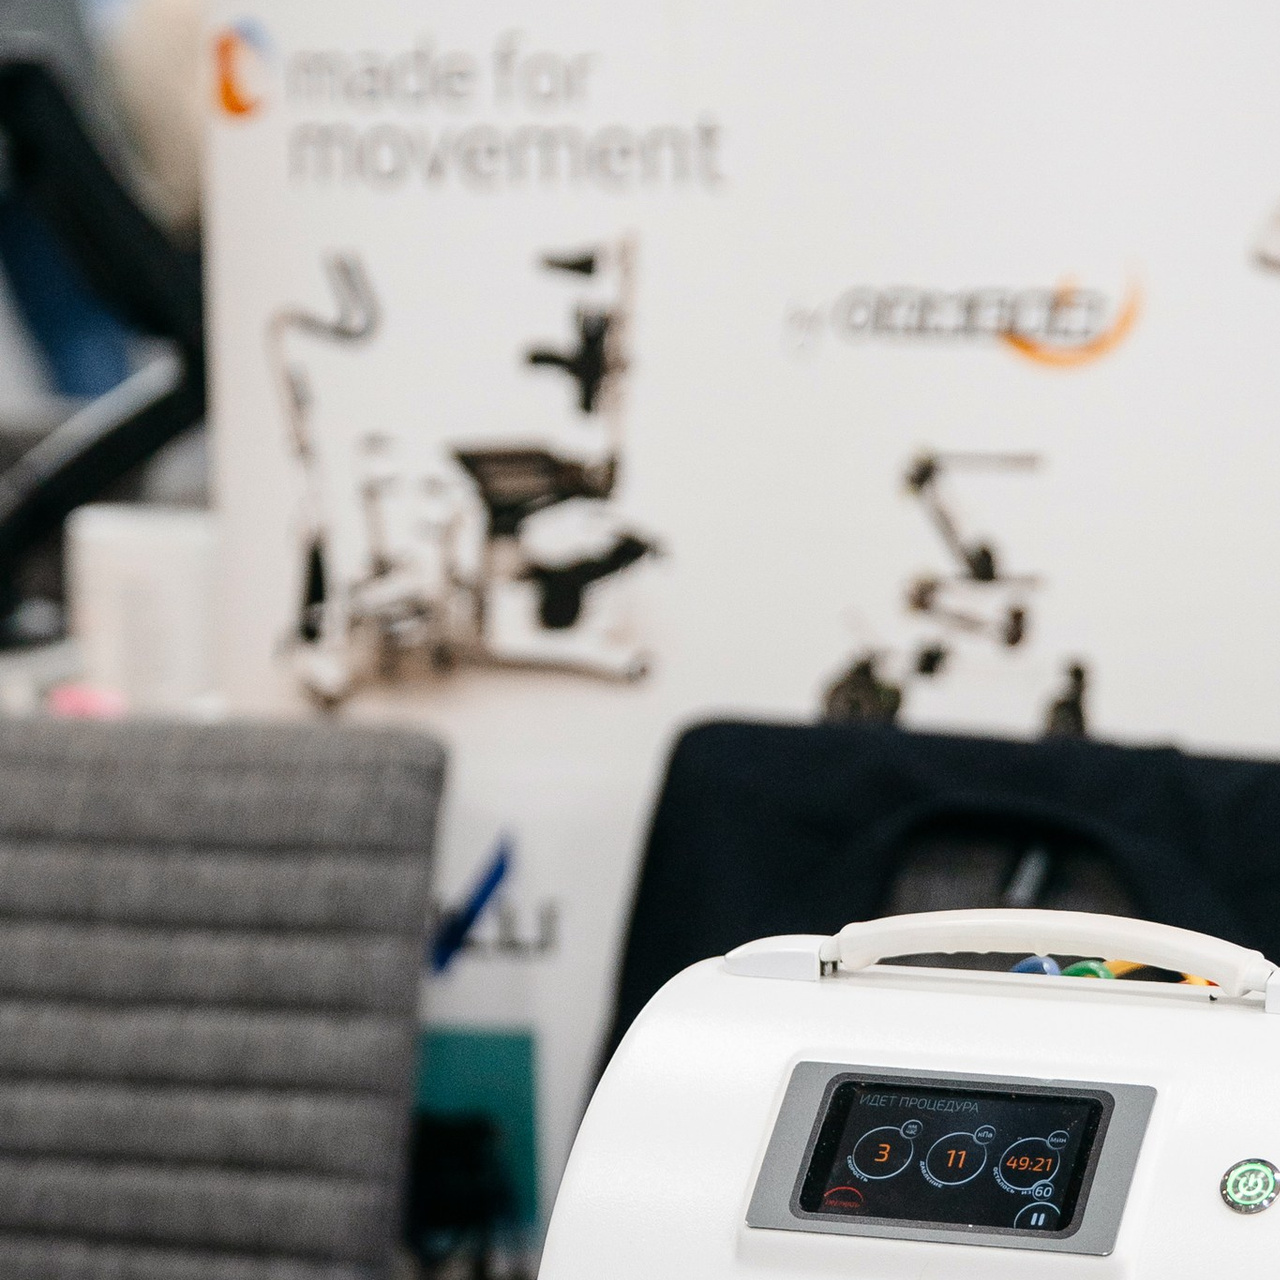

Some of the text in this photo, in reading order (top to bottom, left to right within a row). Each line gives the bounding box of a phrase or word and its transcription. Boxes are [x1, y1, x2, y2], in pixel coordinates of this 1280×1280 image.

[284, 28, 597, 107] made for
[286, 114, 725, 194] movement
[859, 1094, 979, 1113] ИДЕТ ПРОЦЕДУРА
[874, 1143, 891, 1163] 3
[947, 1149, 967, 1169] 11
[1006, 1155, 1053, 1172] 49:21
[846, 1155, 868, 1182] СКОРОСТЬ
[919, 1160, 943, 1188] ДАВЛЕНИЕ
[992, 1166, 1015, 1194] ОСТАЛОСЬ
[1034, 1186, 1053, 1197] 60
